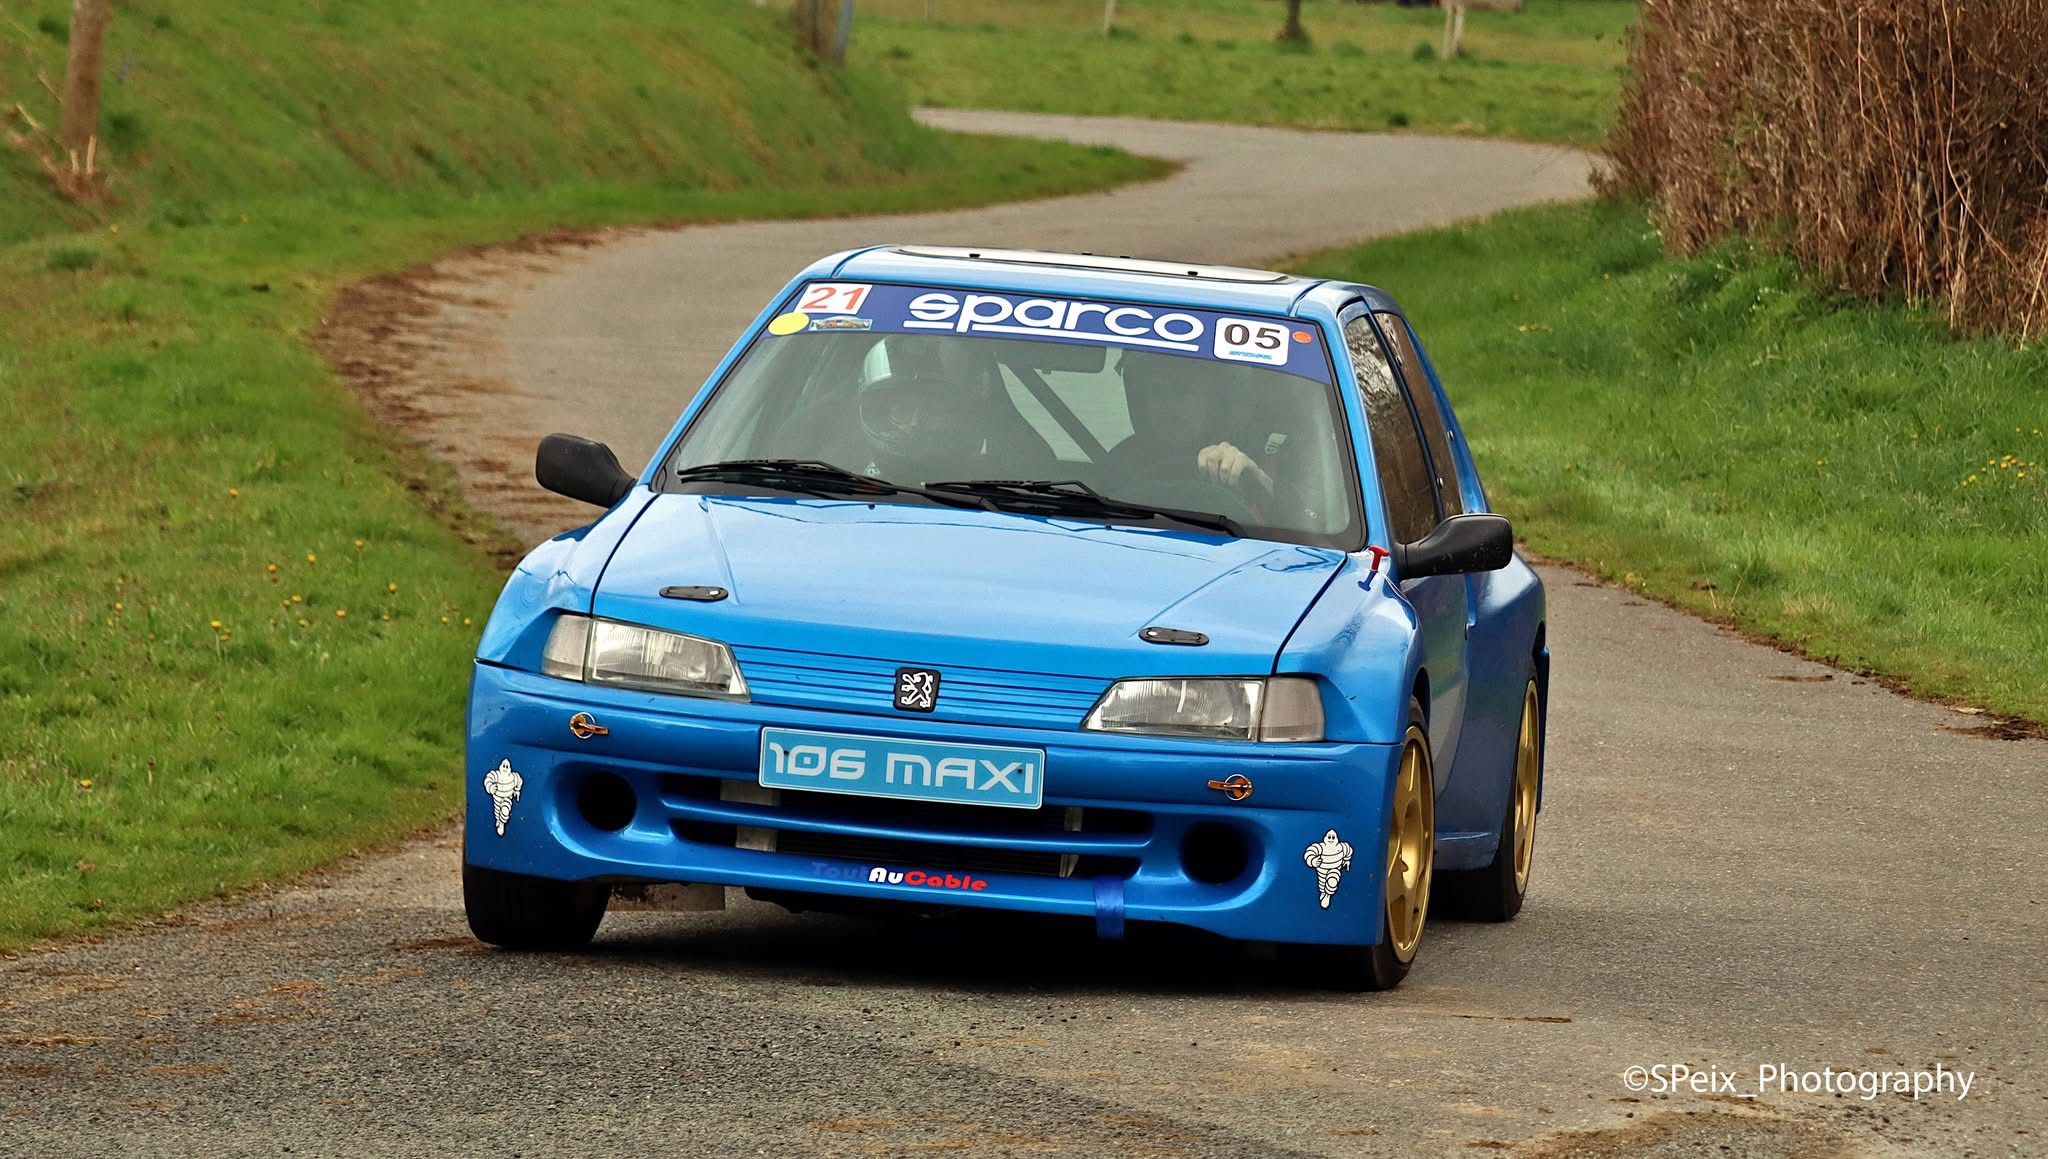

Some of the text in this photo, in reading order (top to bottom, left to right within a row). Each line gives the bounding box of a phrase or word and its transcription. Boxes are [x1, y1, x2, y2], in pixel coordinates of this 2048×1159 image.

[801, 287, 865, 310] 21
[908, 293, 1205, 342] sparco
[1224, 323, 1281, 350] 05
[769, 742, 1034, 794] 106 MAXI
